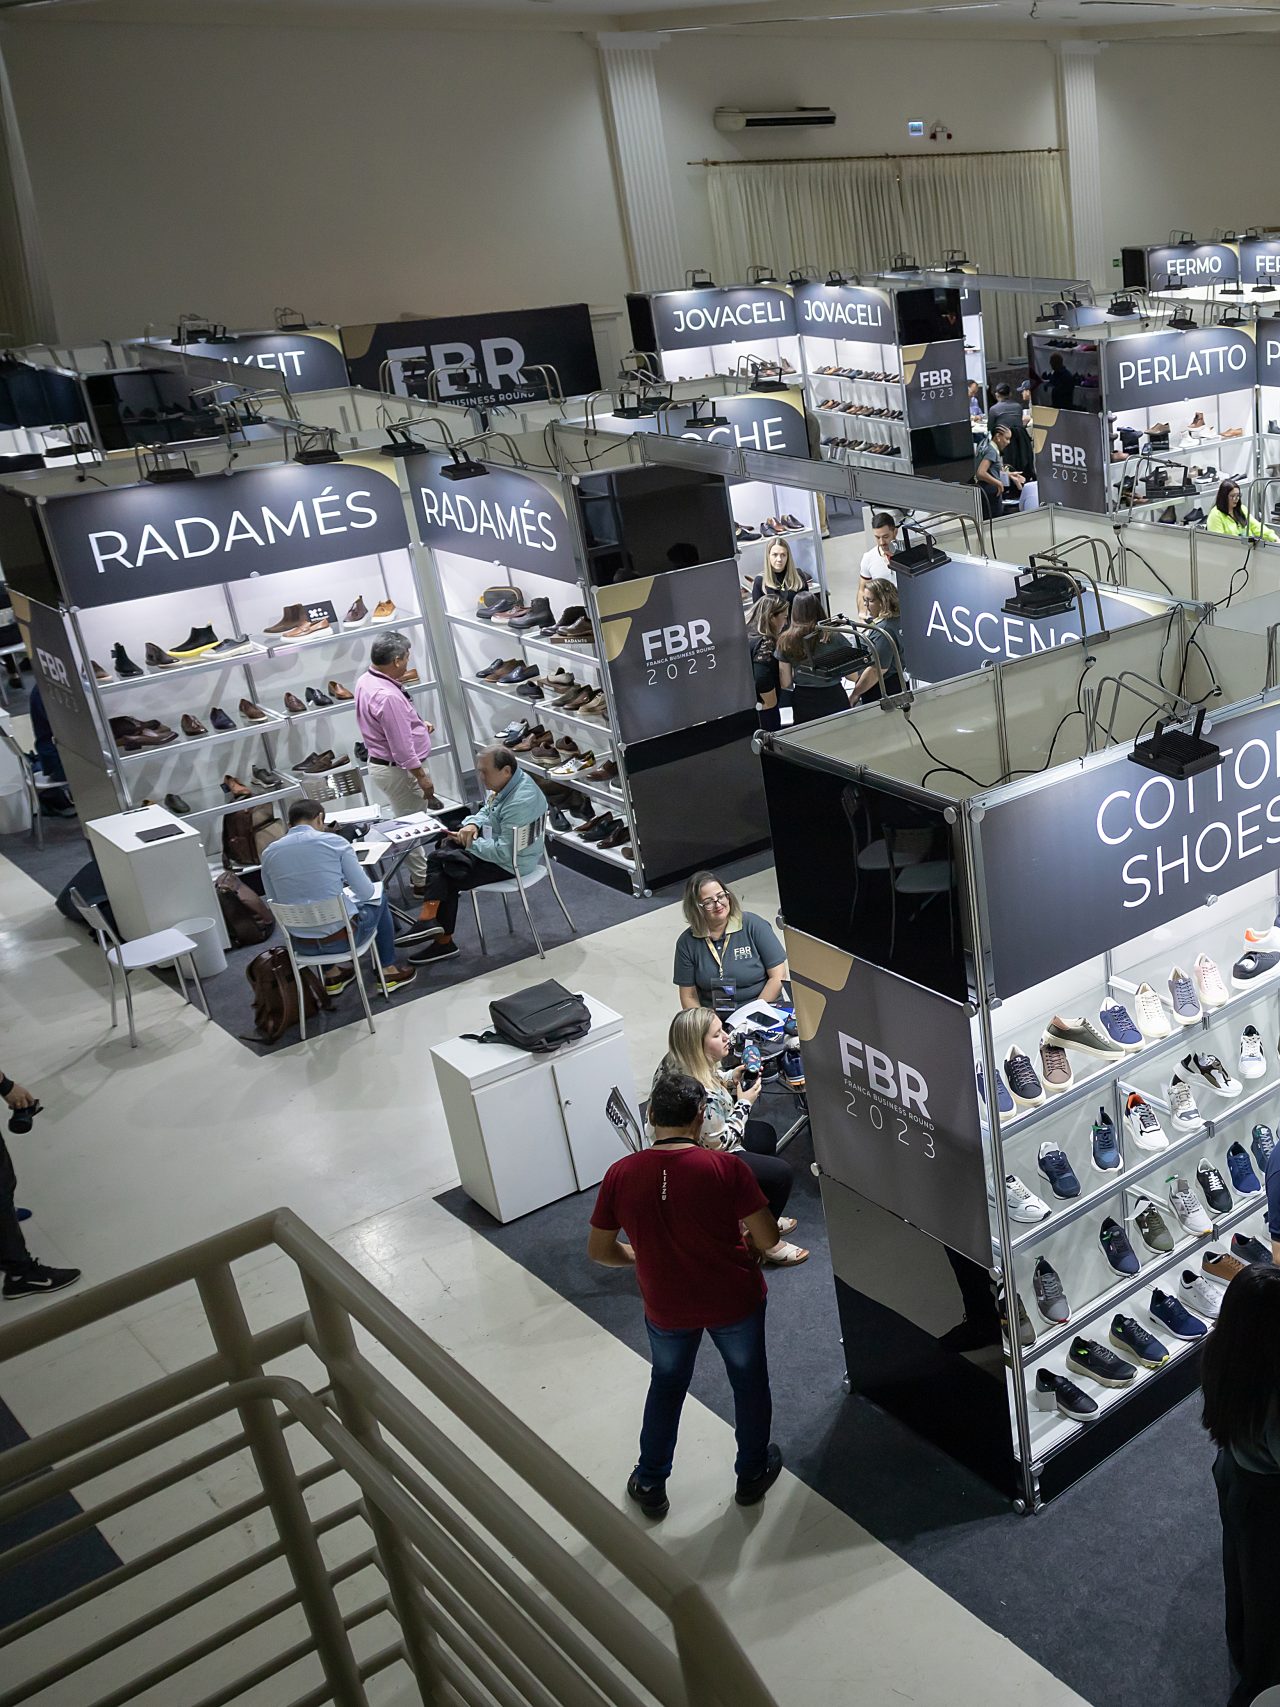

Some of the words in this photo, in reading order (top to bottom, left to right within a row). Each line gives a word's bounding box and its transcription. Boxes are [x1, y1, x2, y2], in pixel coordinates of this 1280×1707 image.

[1166, 255, 1222, 277] FERMO
[673, 300, 786, 333] JOVACELI
[803, 299, 882, 327] JOVACELI
[385, 336, 528, 399] FBR
[919, 368, 953, 388] FBR
[1119, 343, 1247, 390] PERLATTO
[921, 387, 954, 401] 2023
[1050, 443, 1087, 468] FBR
[1052, 467, 1088, 485] 2023
[87, 486, 378, 574] RADAMÉS
[421, 487, 557, 552] RADAMÉS
[641, 618, 713, 661] FBR
[926, 600, 1082, 660] ASCEN
[36, 647, 70, 688] FBR
[646, 657, 669, 668] FRANCA
[669, 650, 695, 662] BUSINESS
[695, 645, 716, 655] ROUND
[646, 653, 717, 686] 2023
[733, 945, 752, 957] FBR
[838, 1030, 932, 1120] FBR
[843, 1078, 872, 1098] FRANCA
[873, 1093, 908, 1117] BUSINESS
[908, 1111, 936, 1132] ROUND
[844, 1090, 936, 1159] 2023
